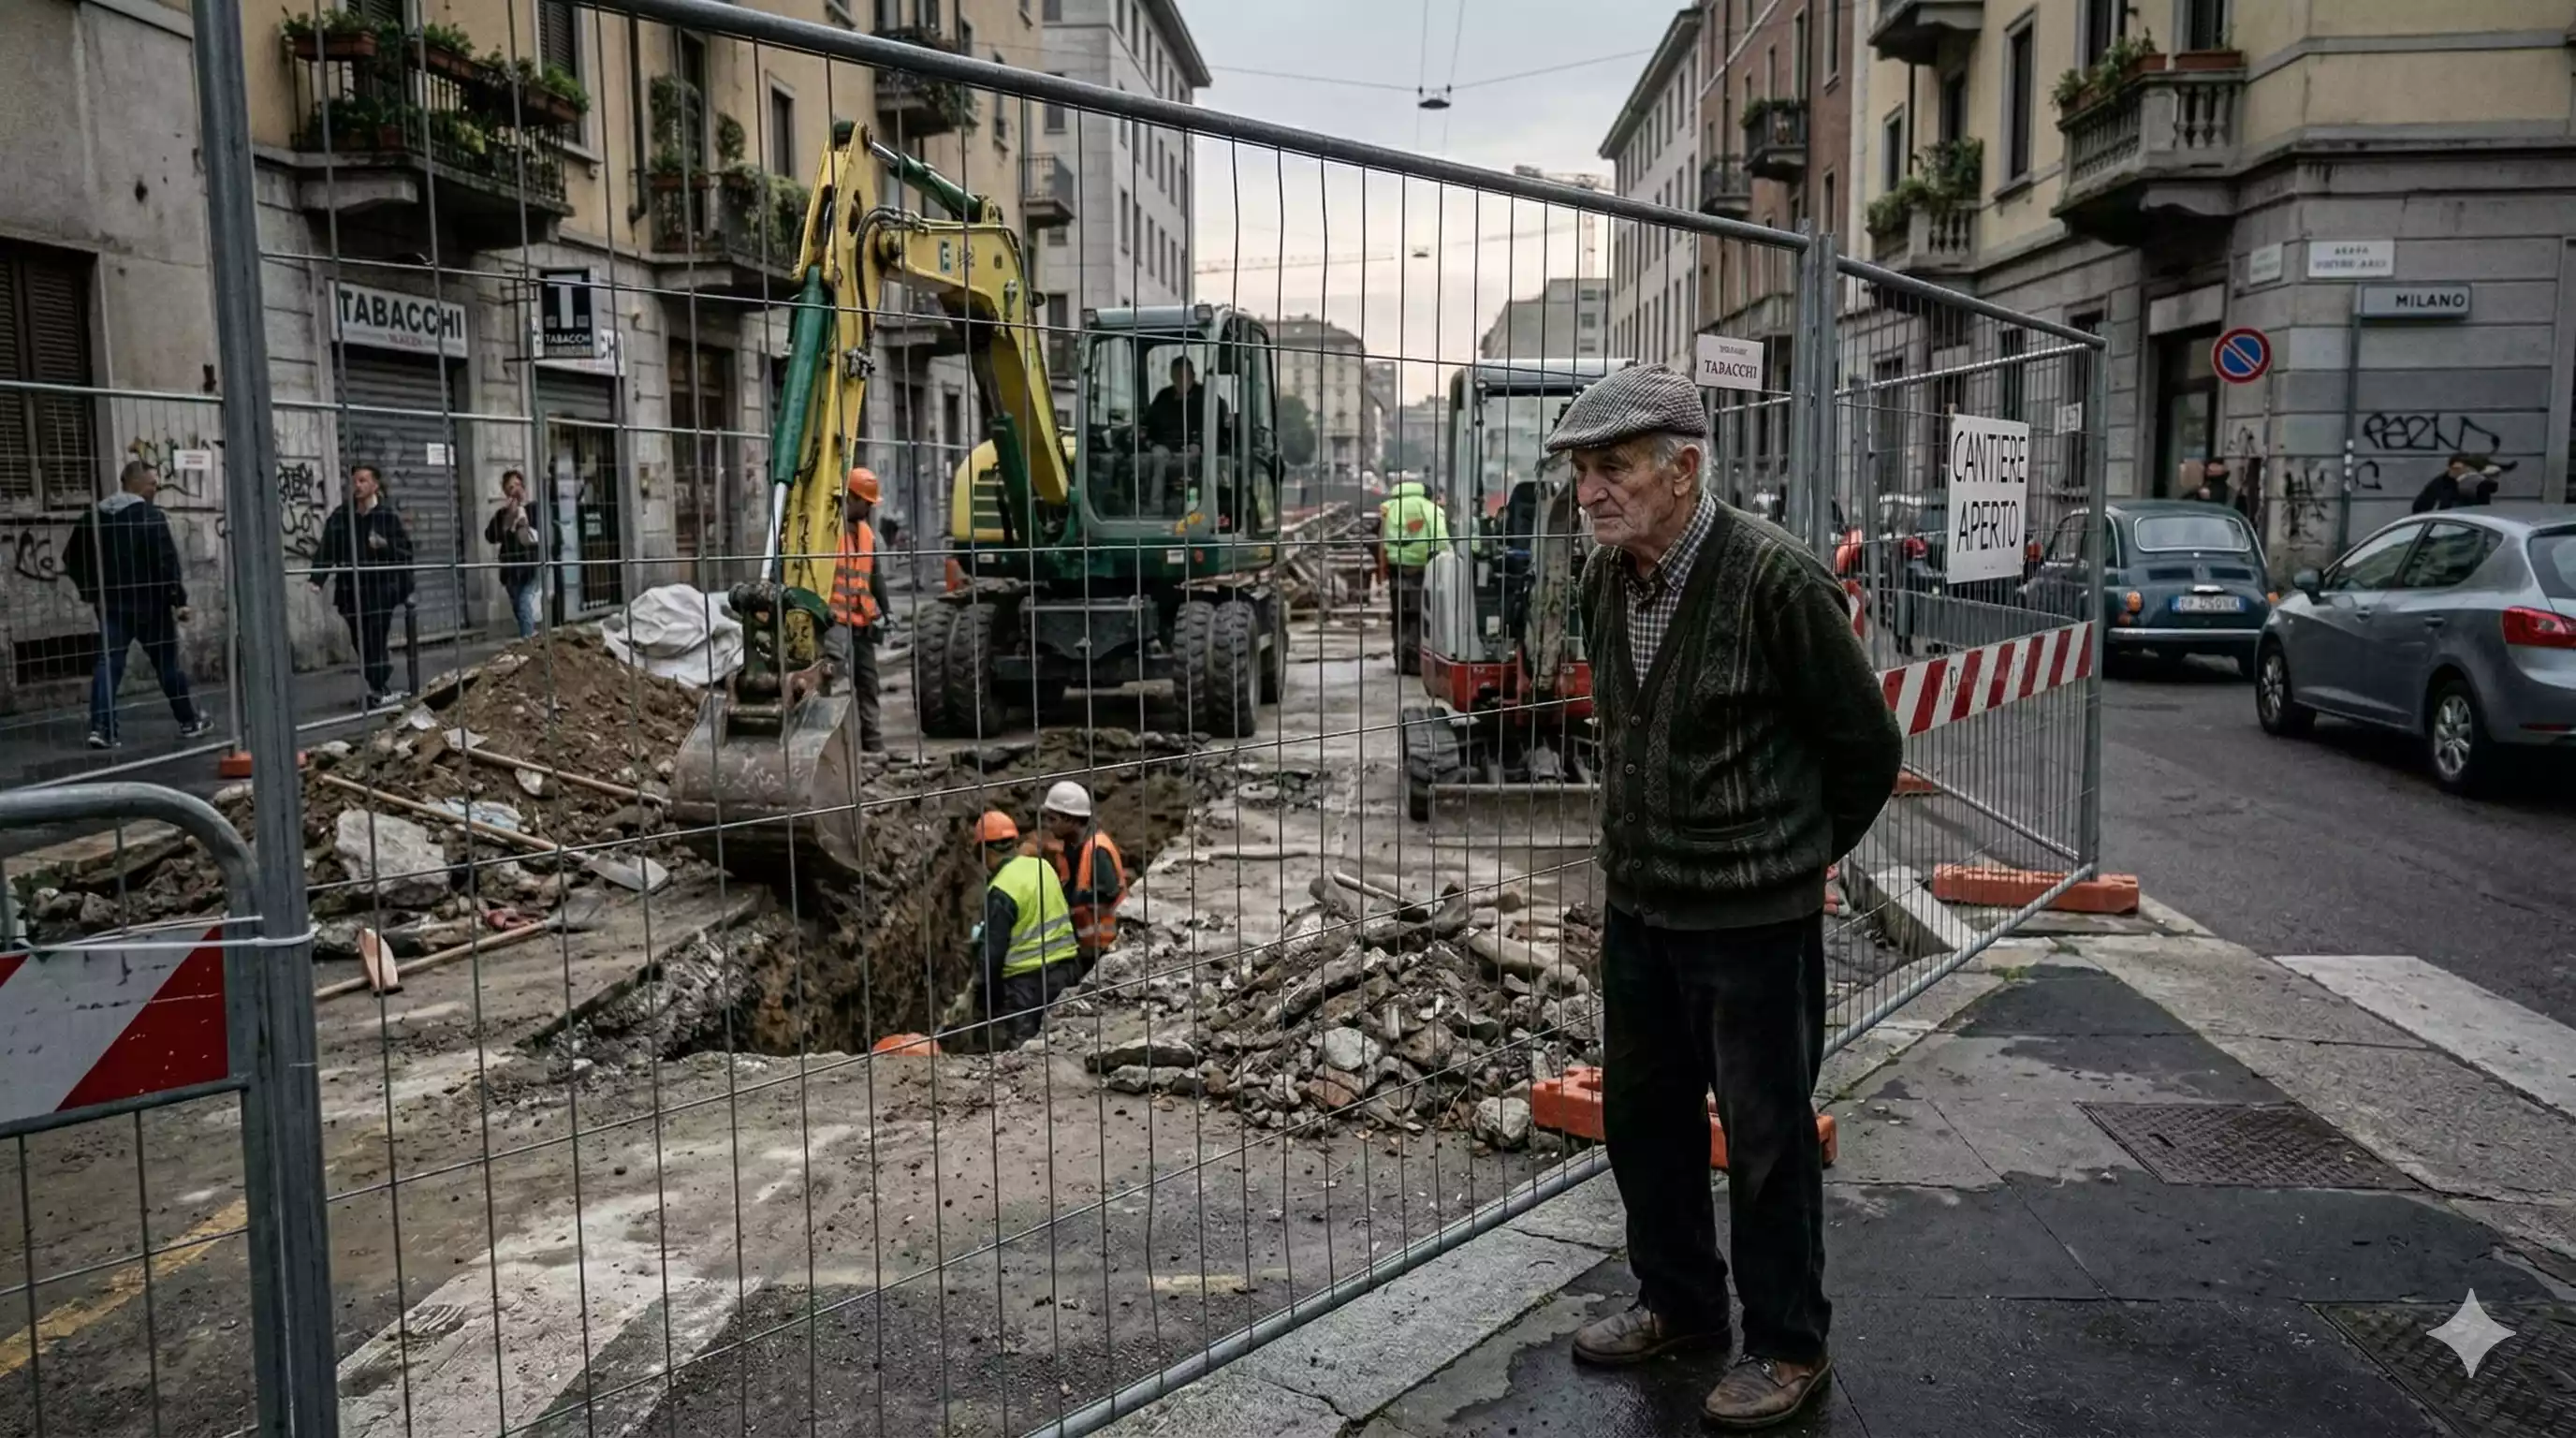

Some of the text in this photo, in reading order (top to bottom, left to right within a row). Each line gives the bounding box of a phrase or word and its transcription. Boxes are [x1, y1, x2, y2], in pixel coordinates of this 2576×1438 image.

[340, 289, 462, 339] TABACCHI
[547, 274, 582, 330] T
[2395, 294, 2466, 308] MILANO
[1704, 360, 1758, 379] TABACCHI
[1953, 431, 2026, 483] CANTIERE
[1956, 500, 2019, 553] APERTO
